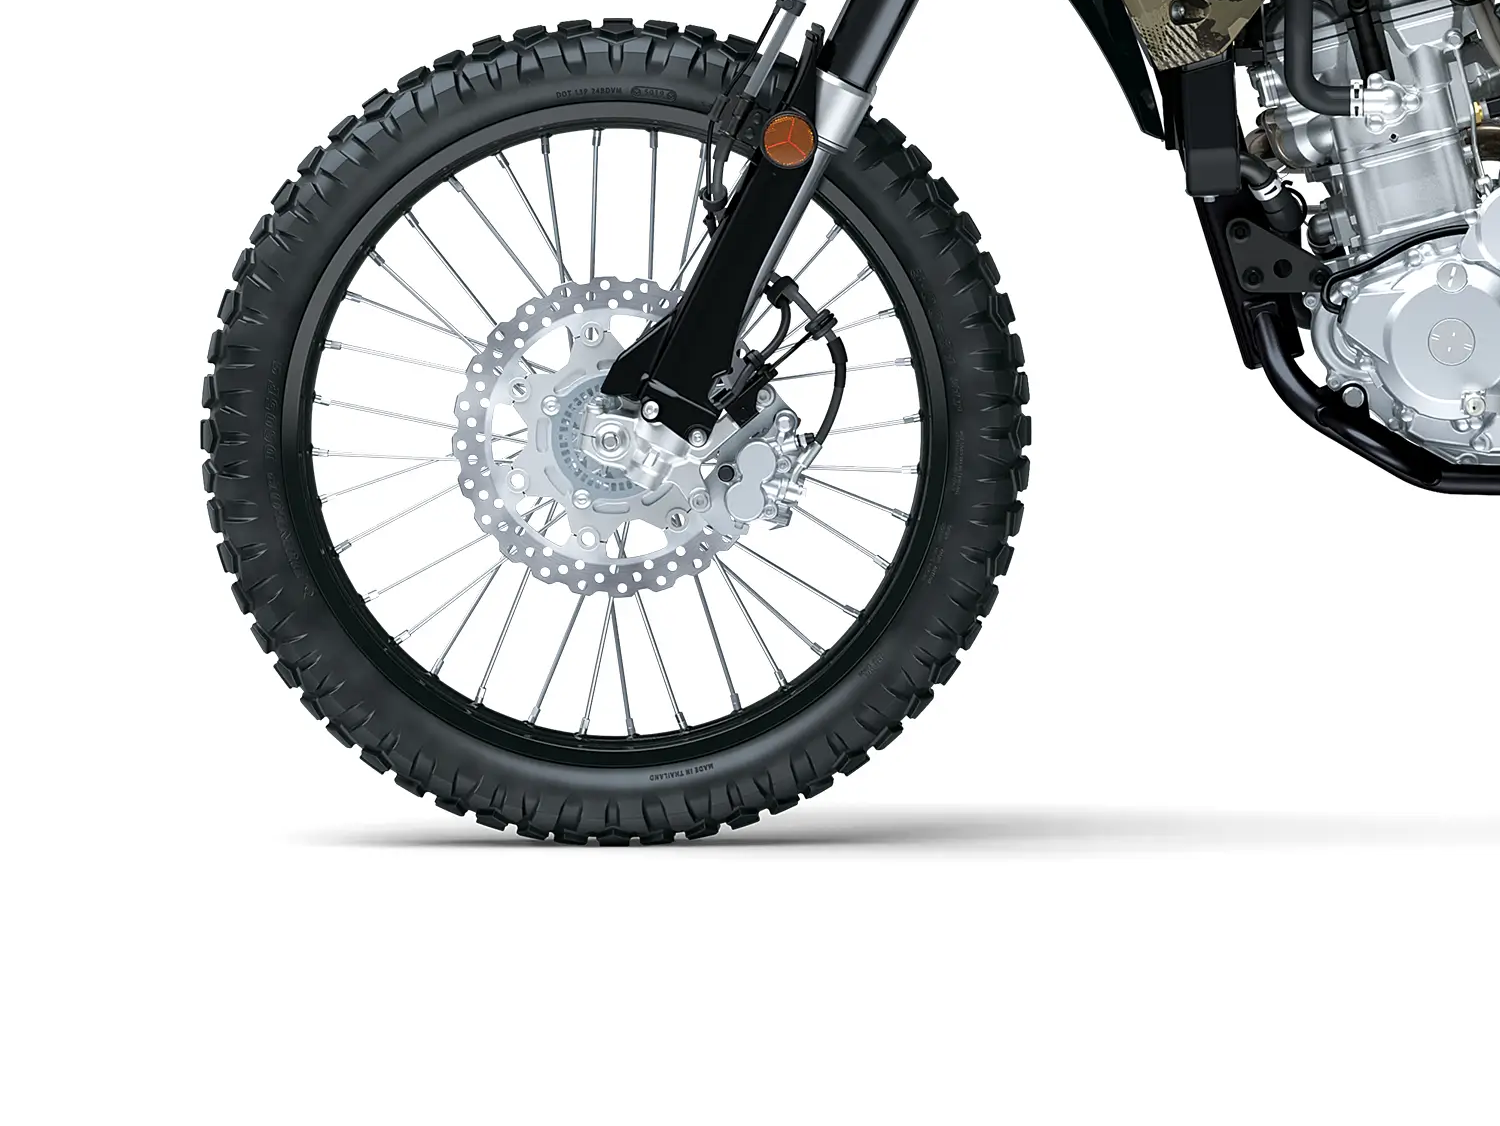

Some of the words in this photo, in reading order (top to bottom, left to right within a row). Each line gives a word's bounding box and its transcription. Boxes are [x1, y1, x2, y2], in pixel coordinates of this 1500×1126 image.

[556, 89, 572, 99] DOT
[685, 767, 693, 776] IN
[694, 762, 714, 773] MADE
[649, 770, 684, 781] THAILAND
